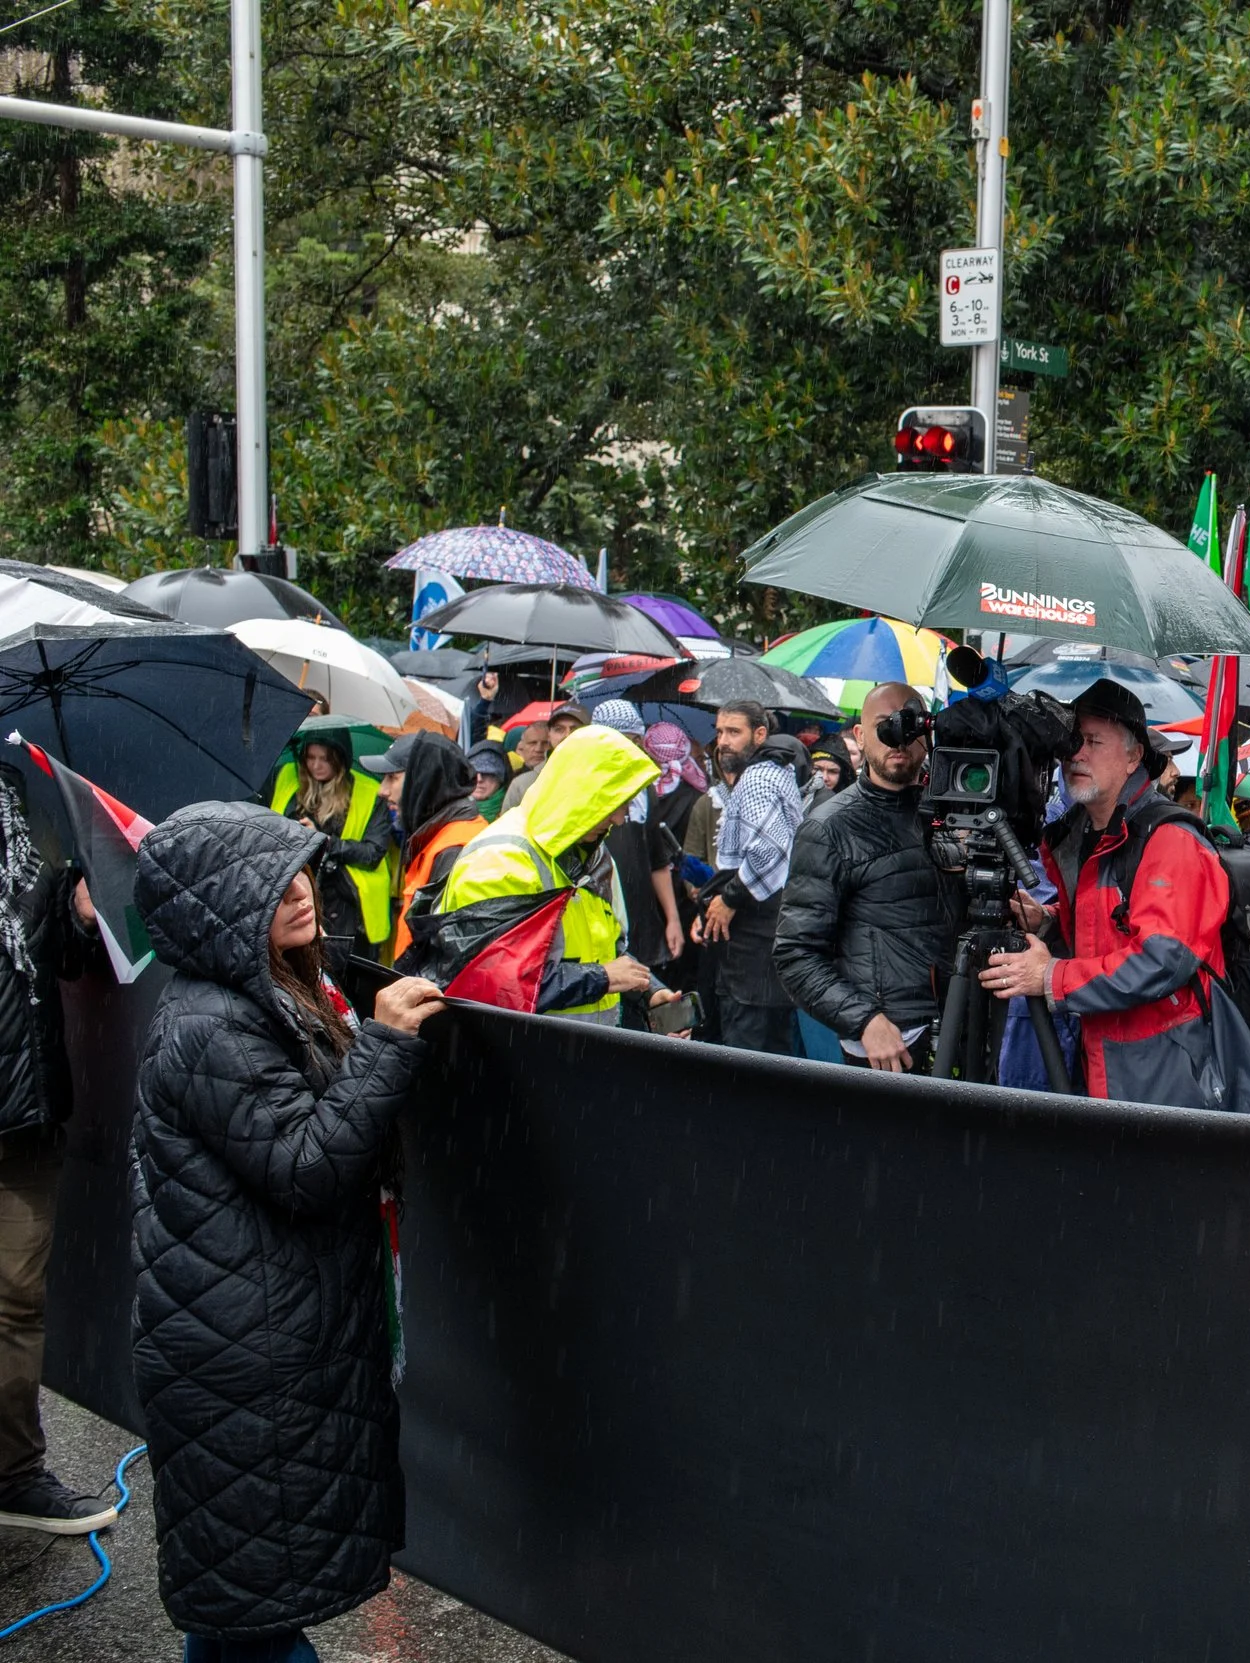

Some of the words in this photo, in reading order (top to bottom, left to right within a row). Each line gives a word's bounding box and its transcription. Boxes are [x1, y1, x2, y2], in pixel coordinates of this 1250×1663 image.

[945, 255, 994, 269] CLEARWAY
[947, 276, 958, 295] C
[975, 327, 988, 335] FRI
[1015, 342, 1038, 361] York
[1039, 346, 1049, 363] St
[979, 582, 1096, 615] BUNNINGS
[987, 601, 1088, 625] warehouse
